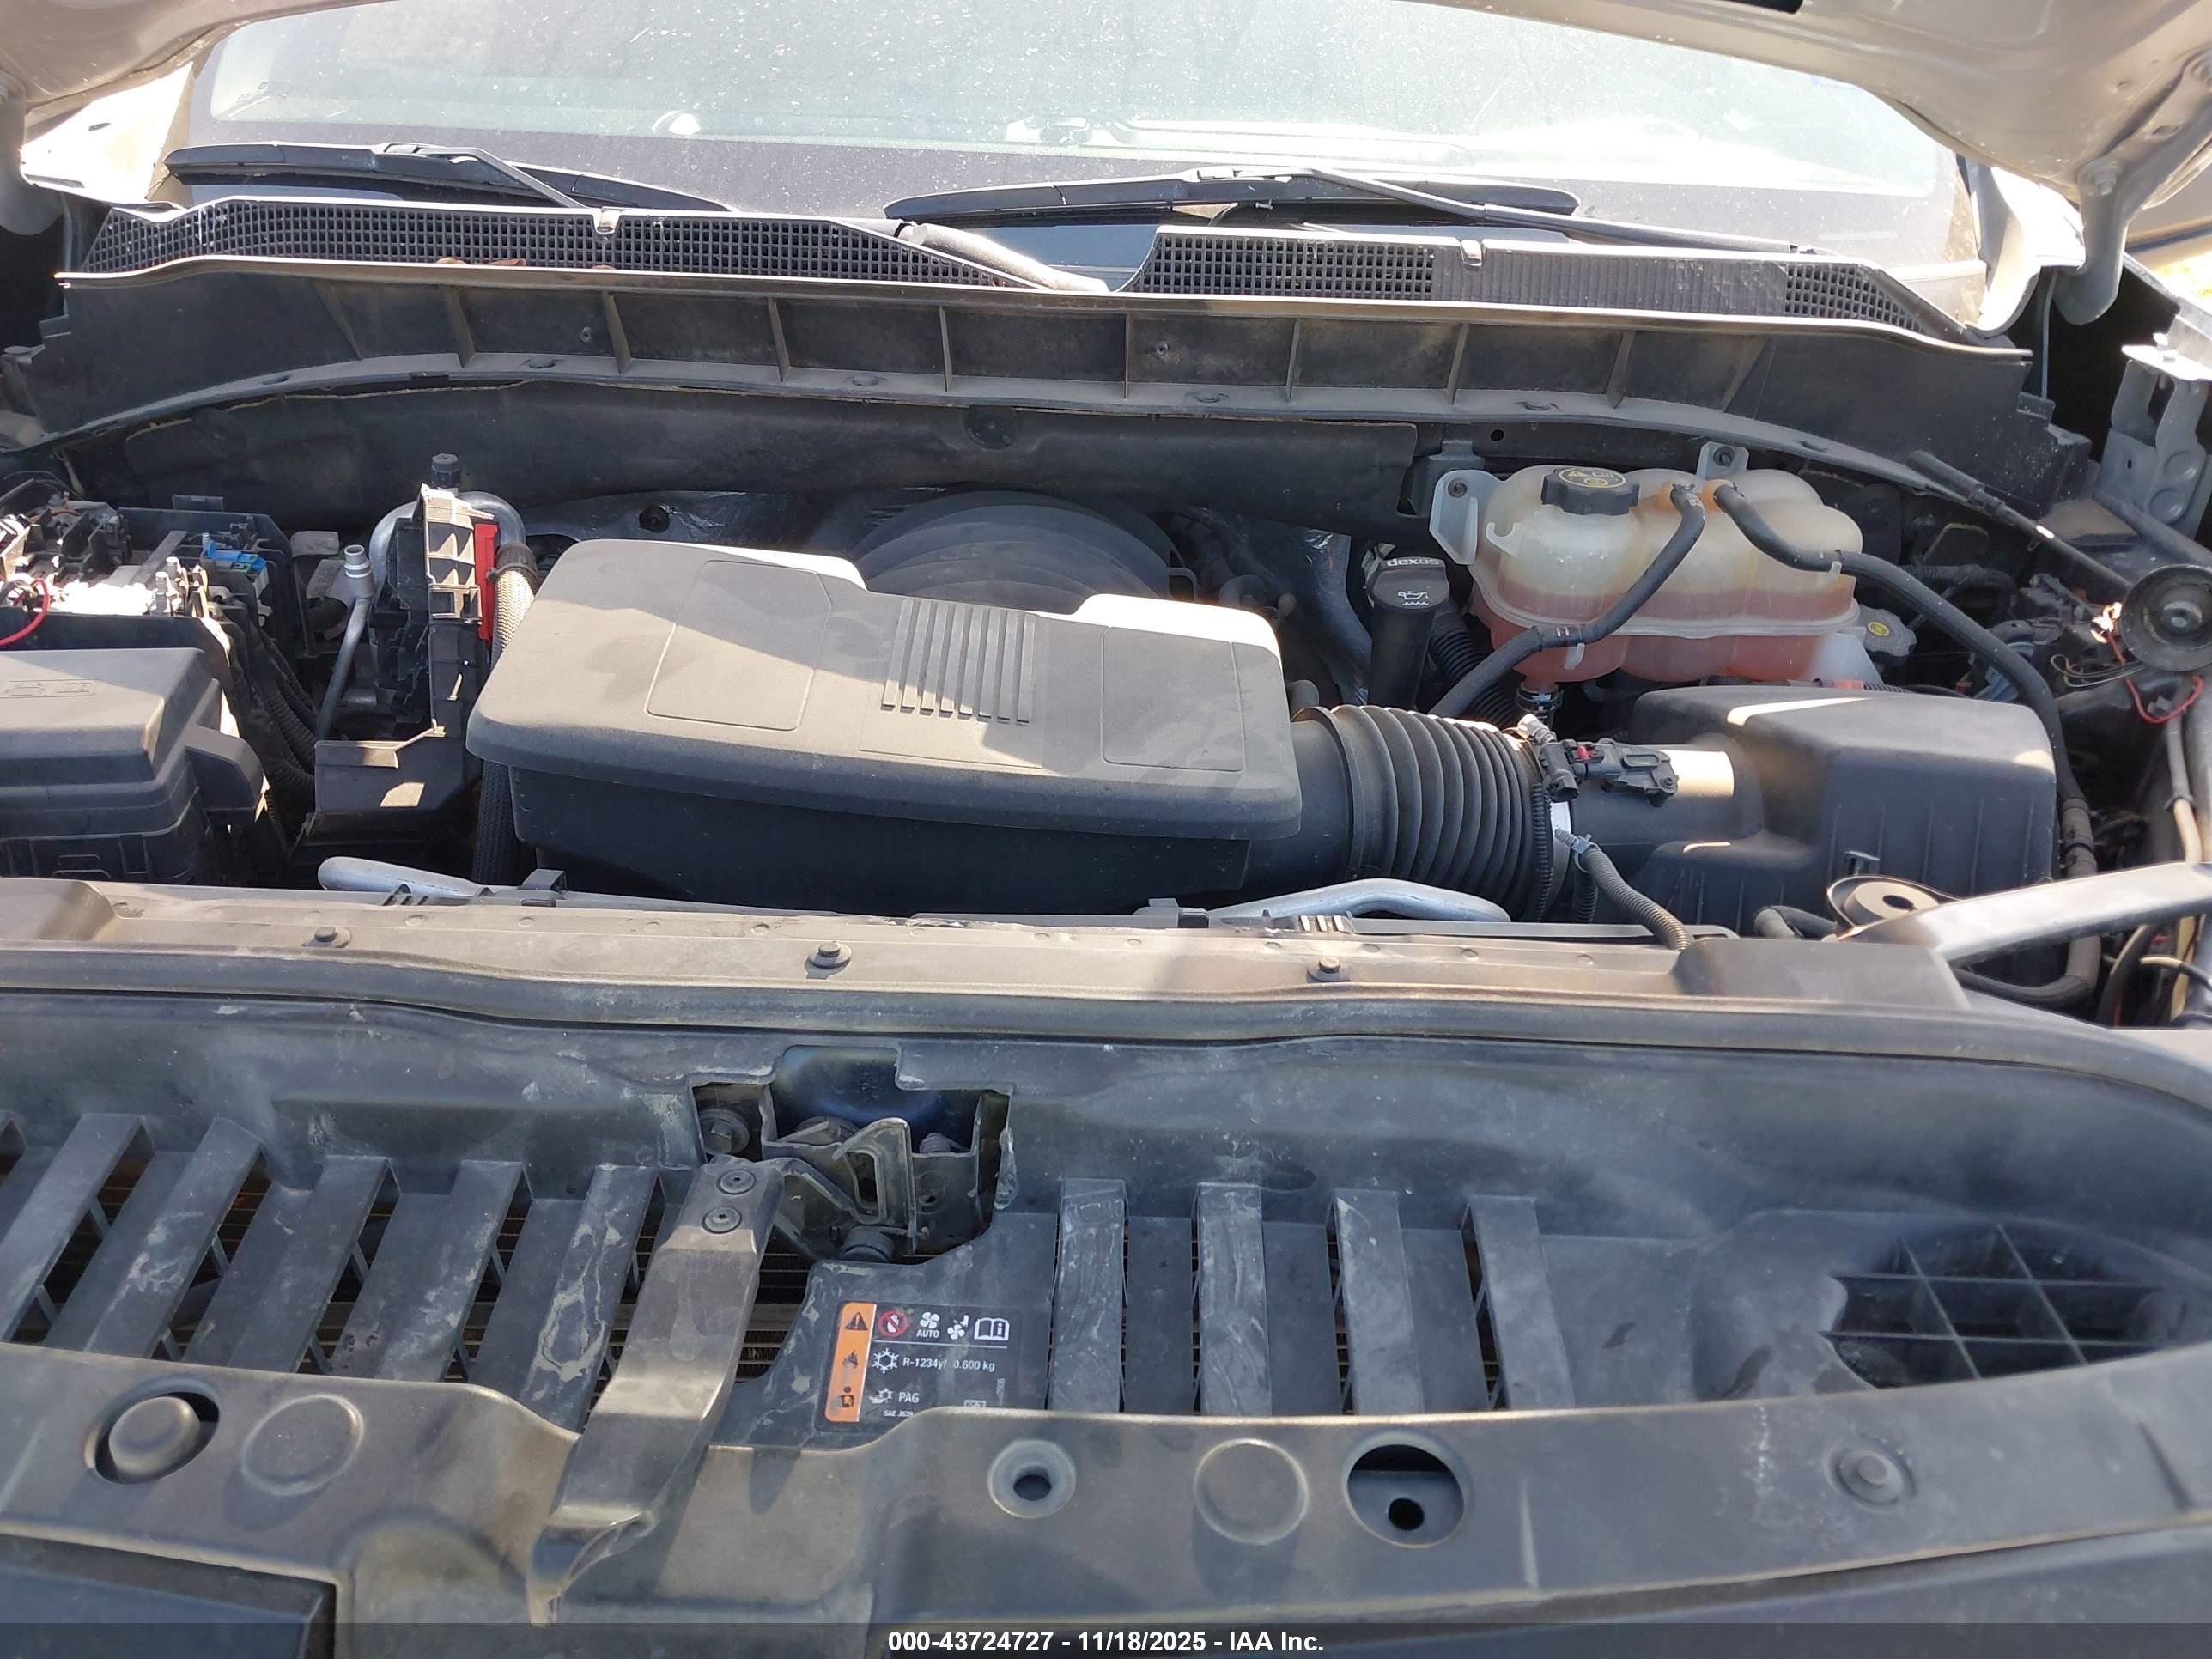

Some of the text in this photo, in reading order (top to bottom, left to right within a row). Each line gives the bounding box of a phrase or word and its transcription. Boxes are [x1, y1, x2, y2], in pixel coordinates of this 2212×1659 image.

[1387, 558, 1440, 567] dexos
[916, 1329, 939, 1339] AUTO
[902, 1357, 995, 1372] R-1234yf 0.600 kg
[898, 1392, 920, 1403] PAG
